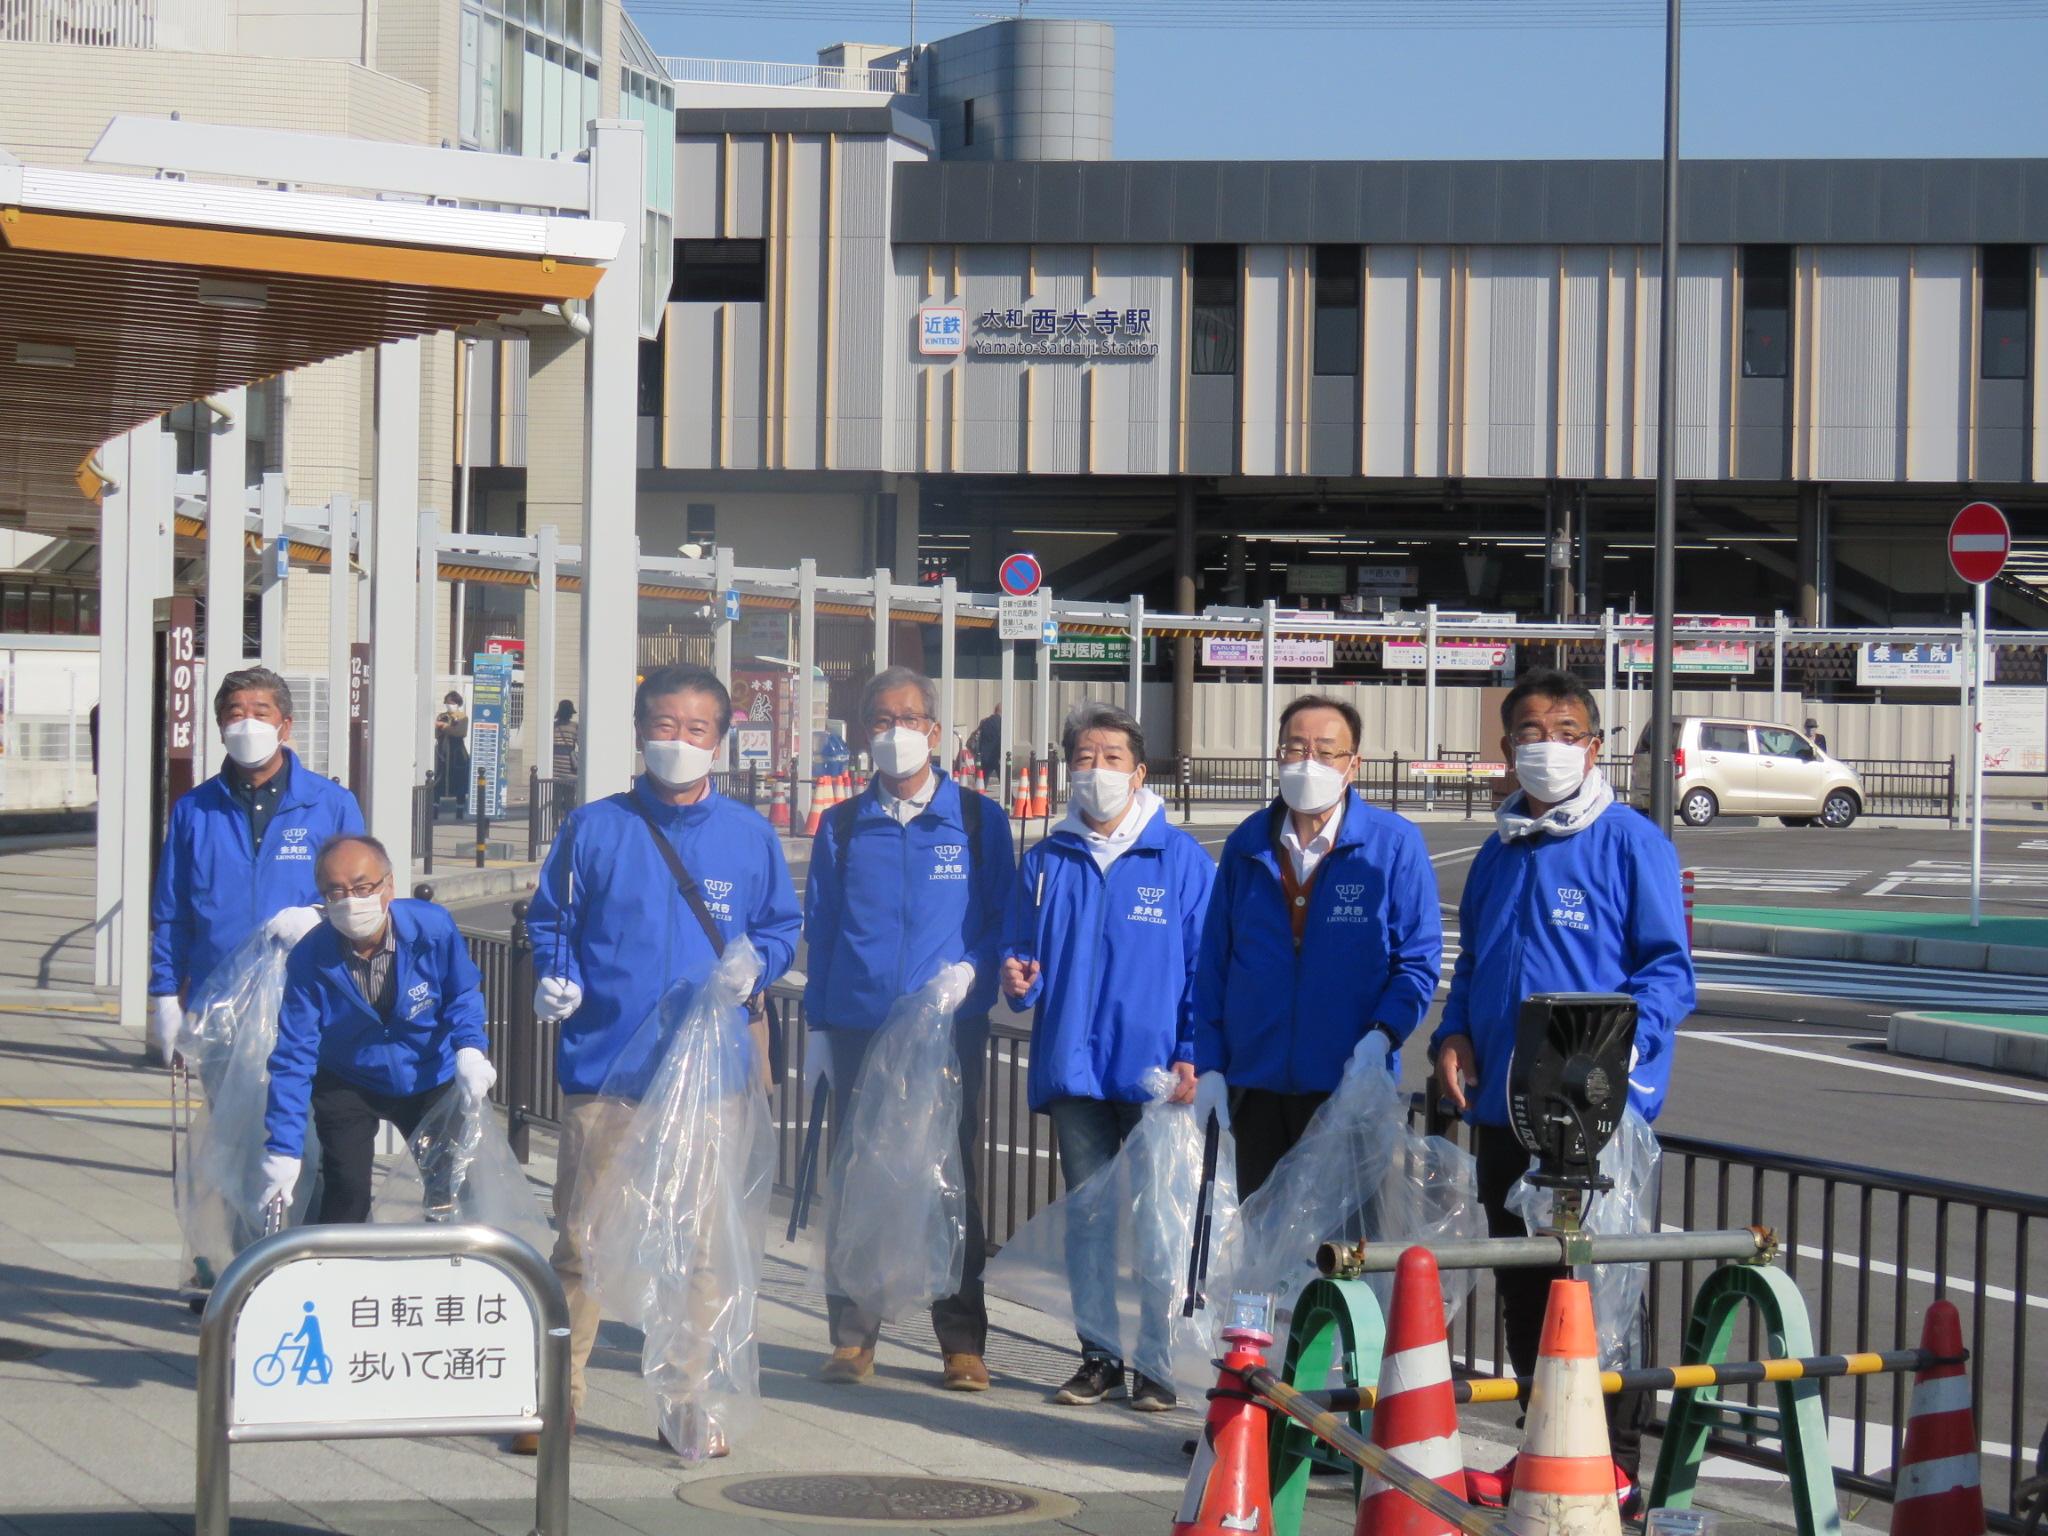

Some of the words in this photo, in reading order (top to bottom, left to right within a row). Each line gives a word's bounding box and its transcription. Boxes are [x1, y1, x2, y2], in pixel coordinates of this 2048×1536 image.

[925, 316, 961, 335] 近鉄
[982, 308, 1151, 335] 大和西大寺駅
[925, 337, 960, 346] KINTETSU
[976, 340, 1096, 358] Yamato-Saidaiji
[1102, 340, 1159, 356] Station
[172, 626, 194, 748] 13のりば
[351, 657, 362, 718] 12のりば
[351, 1293, 507, 1328] 自転車は
[348, 1347, 507, 1383] 歩いて通行
